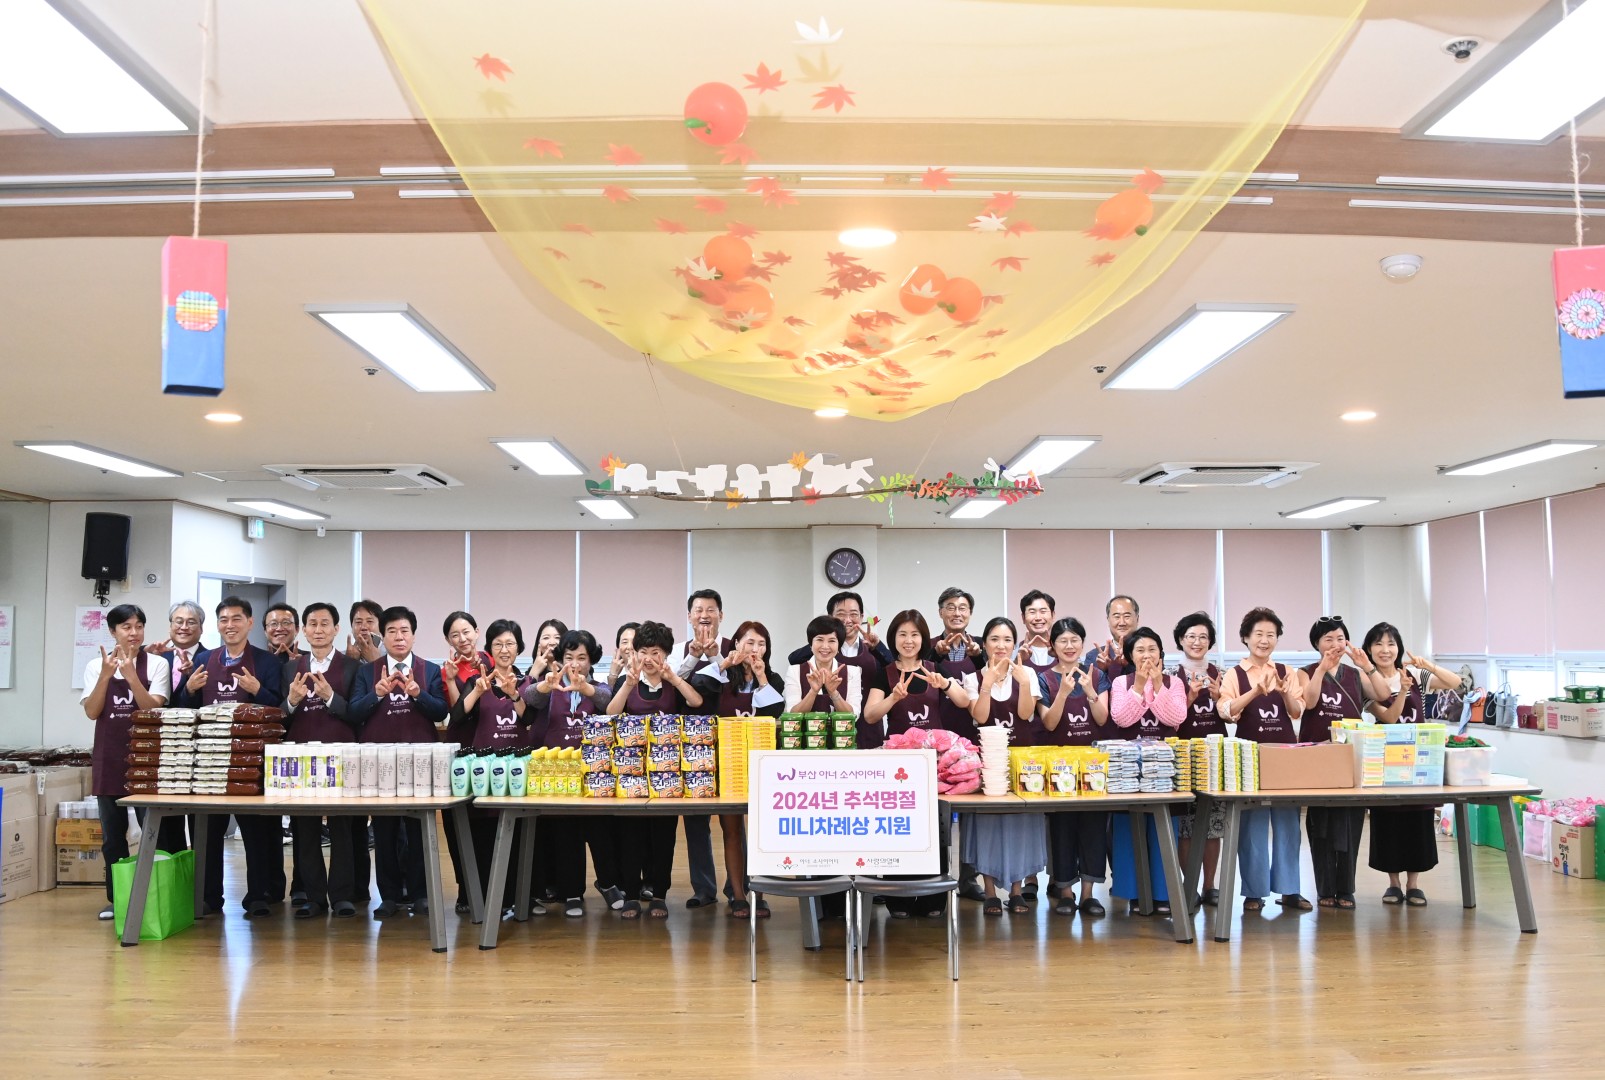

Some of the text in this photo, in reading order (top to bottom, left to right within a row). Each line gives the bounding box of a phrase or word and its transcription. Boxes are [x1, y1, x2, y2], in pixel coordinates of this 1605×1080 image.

[798, 770, 816, 780] 부산
[819, 770, 837, 779] 아너
[840, 770, 885, 779] 소사이어티
[773, 790, 916, 810] 2024년 추석명절
[778, 816, 911, 836] 미니차례상 지원
